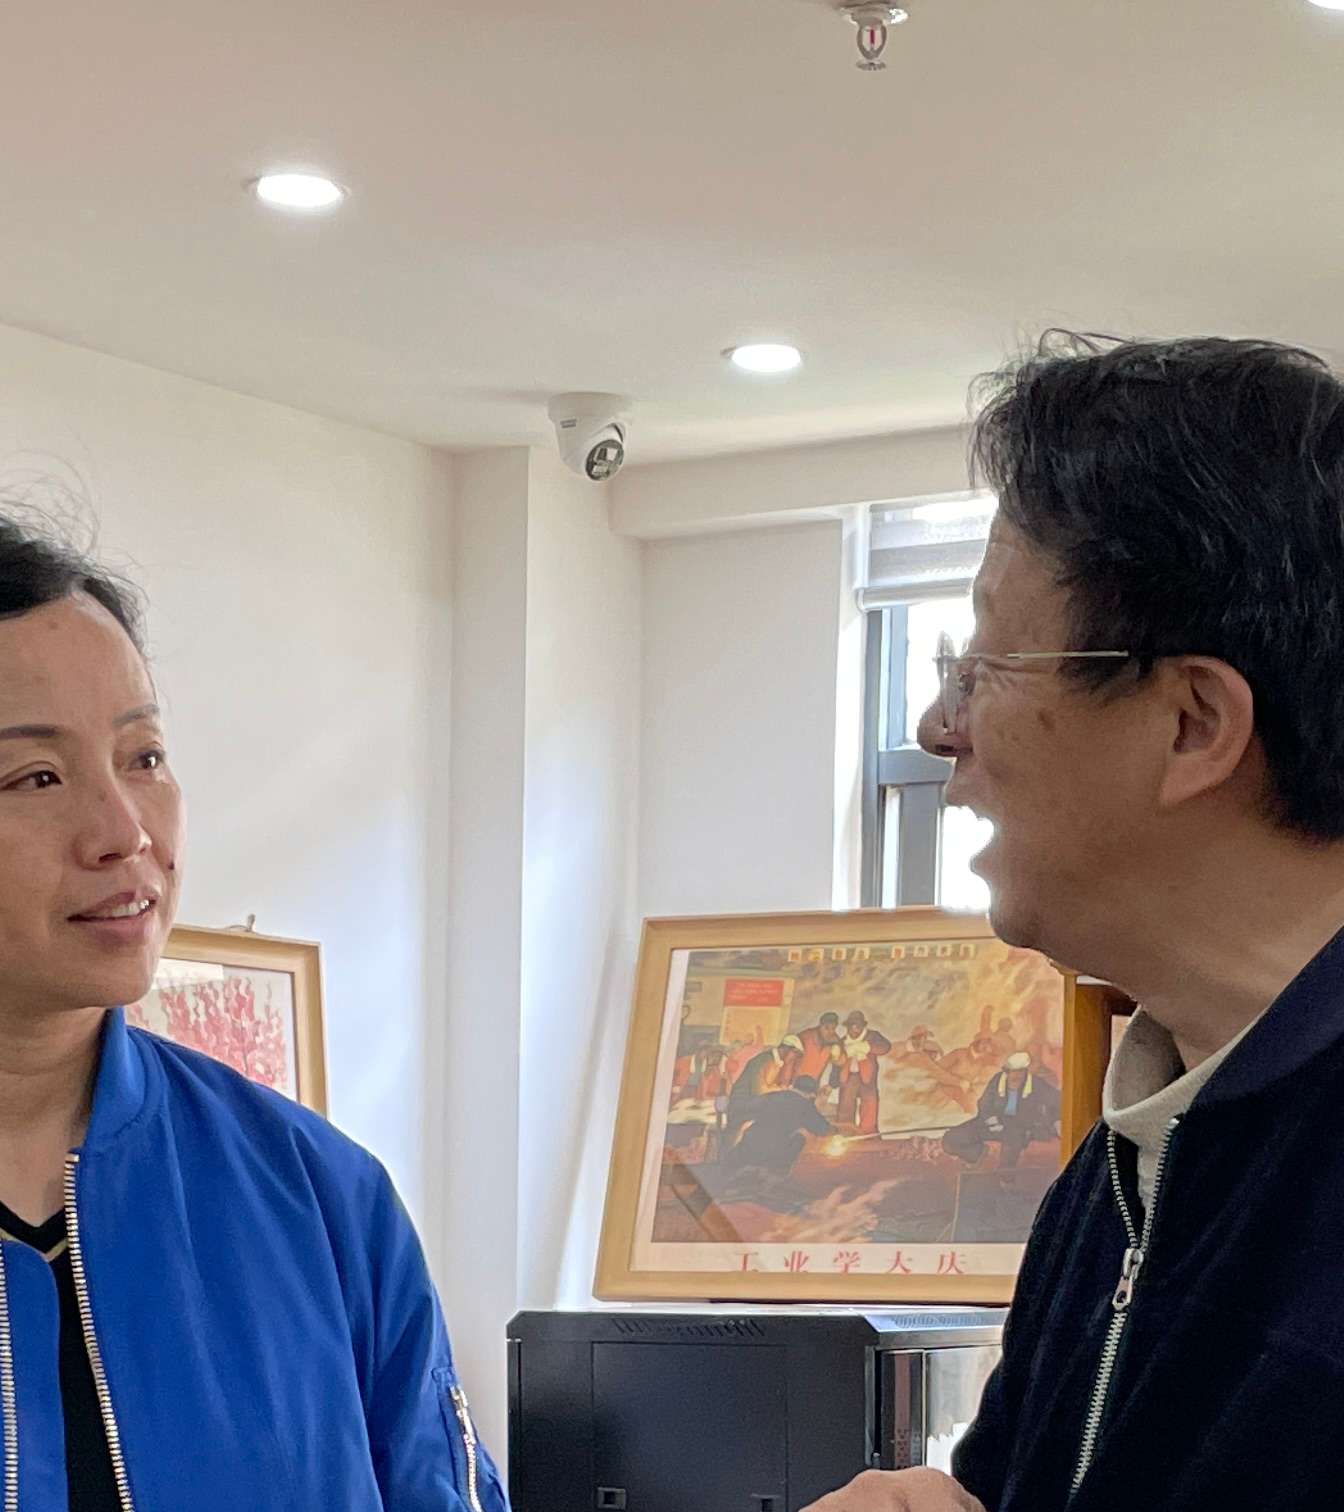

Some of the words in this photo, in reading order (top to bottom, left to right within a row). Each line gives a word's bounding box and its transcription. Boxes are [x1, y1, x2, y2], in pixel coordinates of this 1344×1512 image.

[735, 1250, 965, 1275] 工业学大庆
